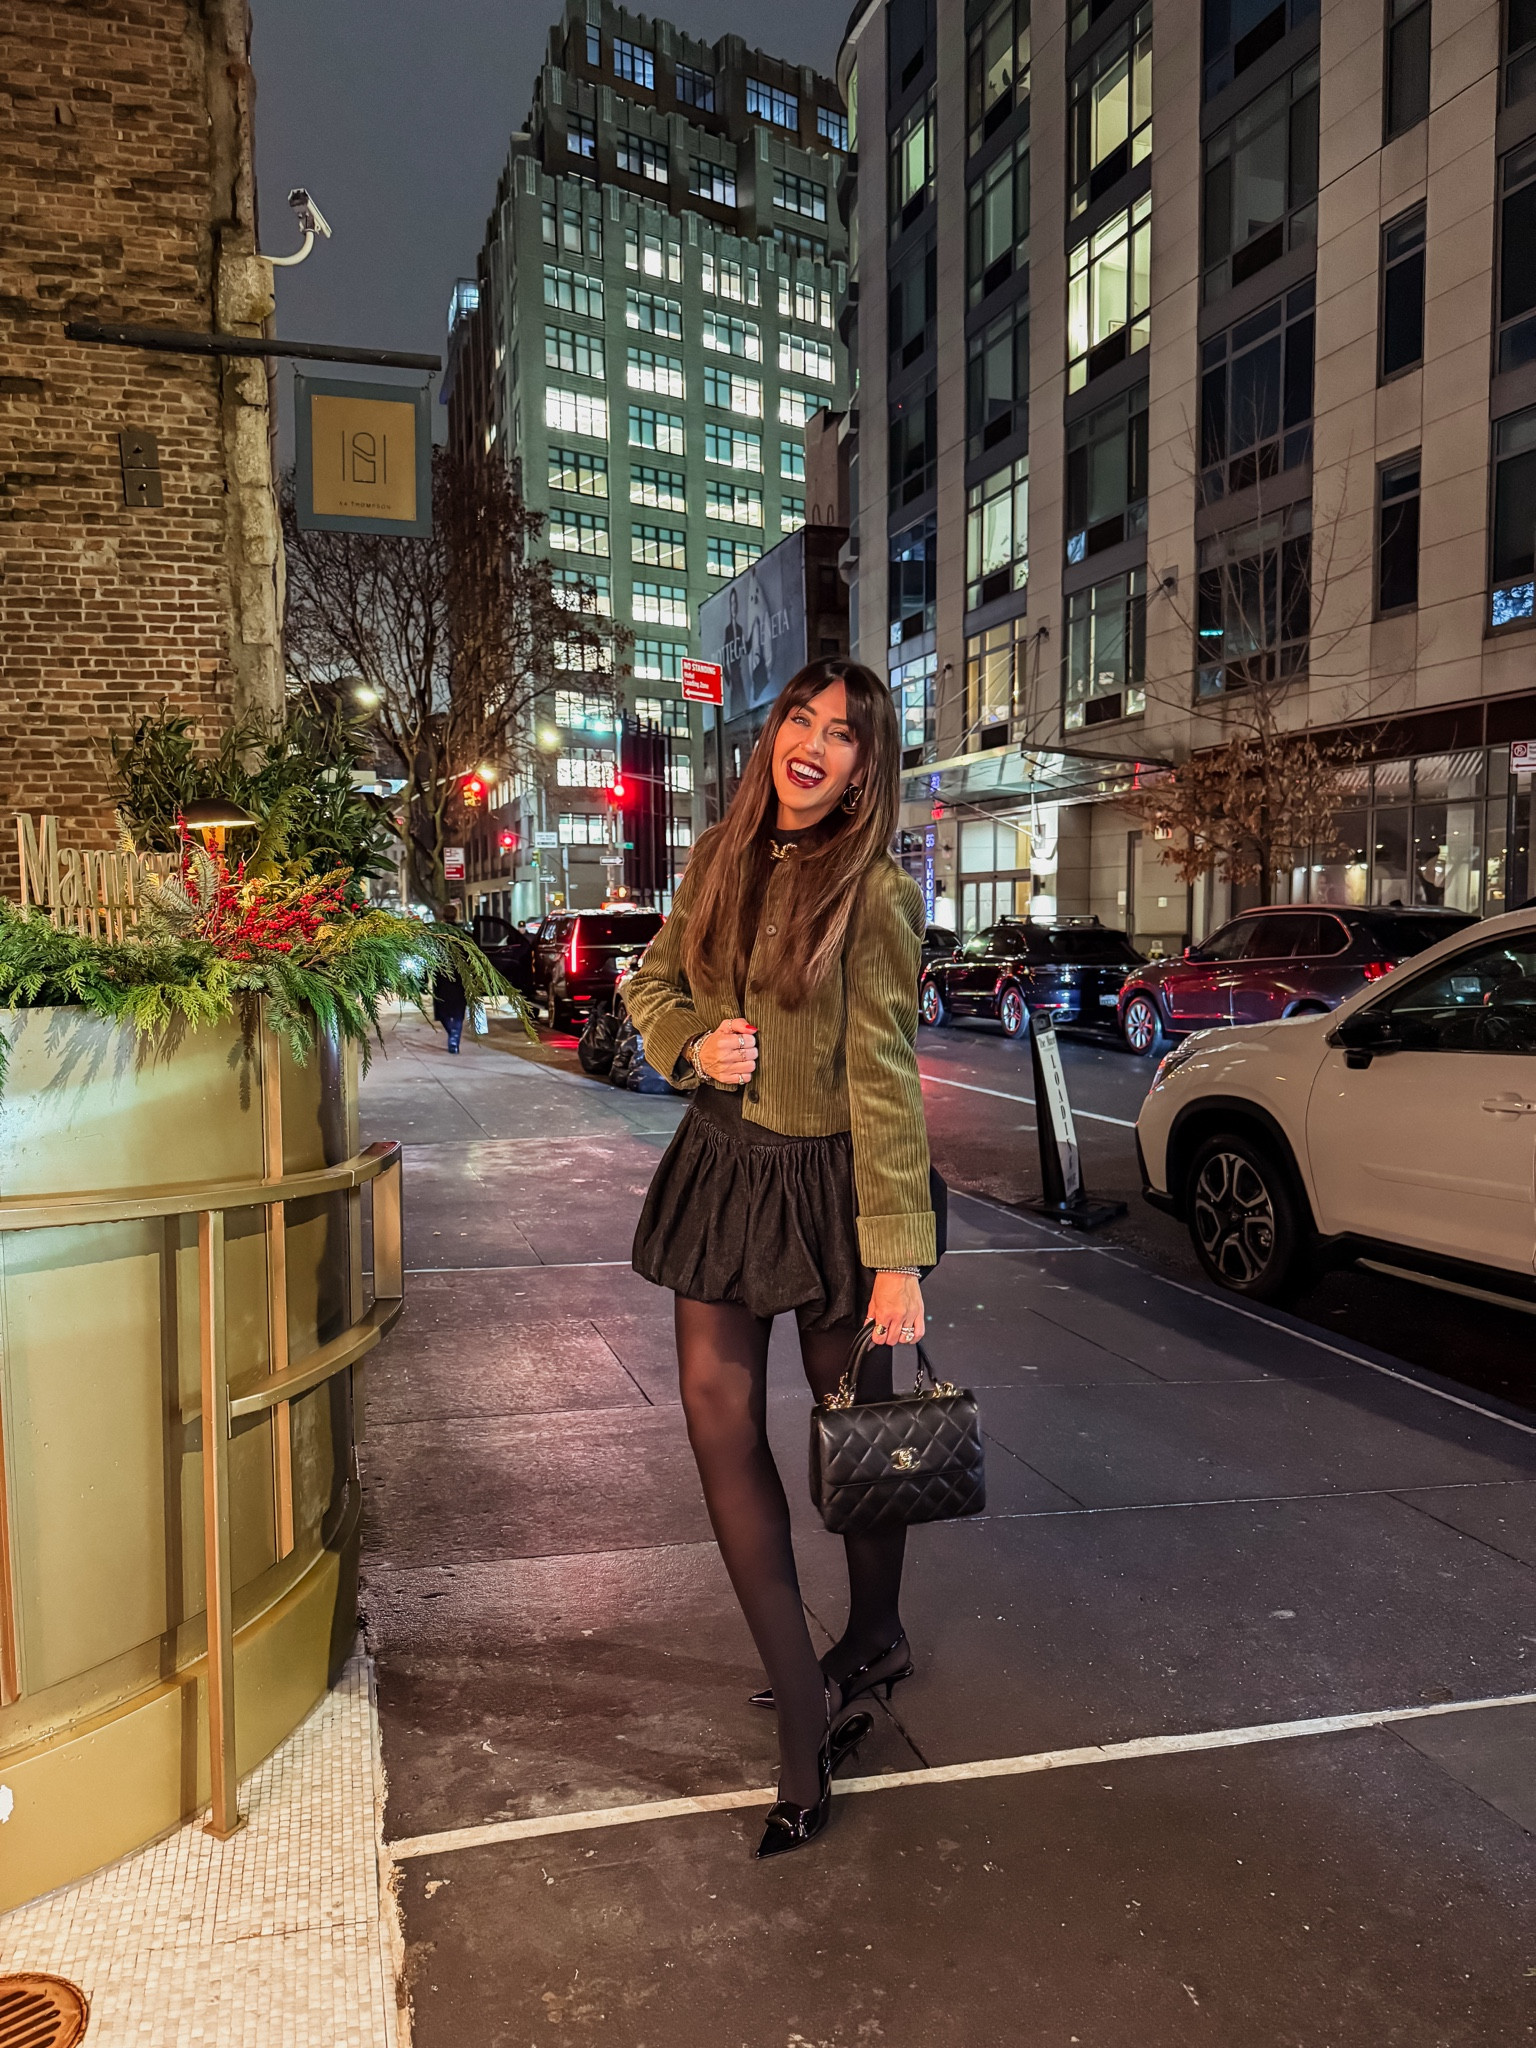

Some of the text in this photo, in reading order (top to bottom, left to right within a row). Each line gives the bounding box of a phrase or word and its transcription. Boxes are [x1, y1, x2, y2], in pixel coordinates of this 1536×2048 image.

[684, 662, 716, 675] NO STANDING
[684, 679, 709, 690] Loading Zone
